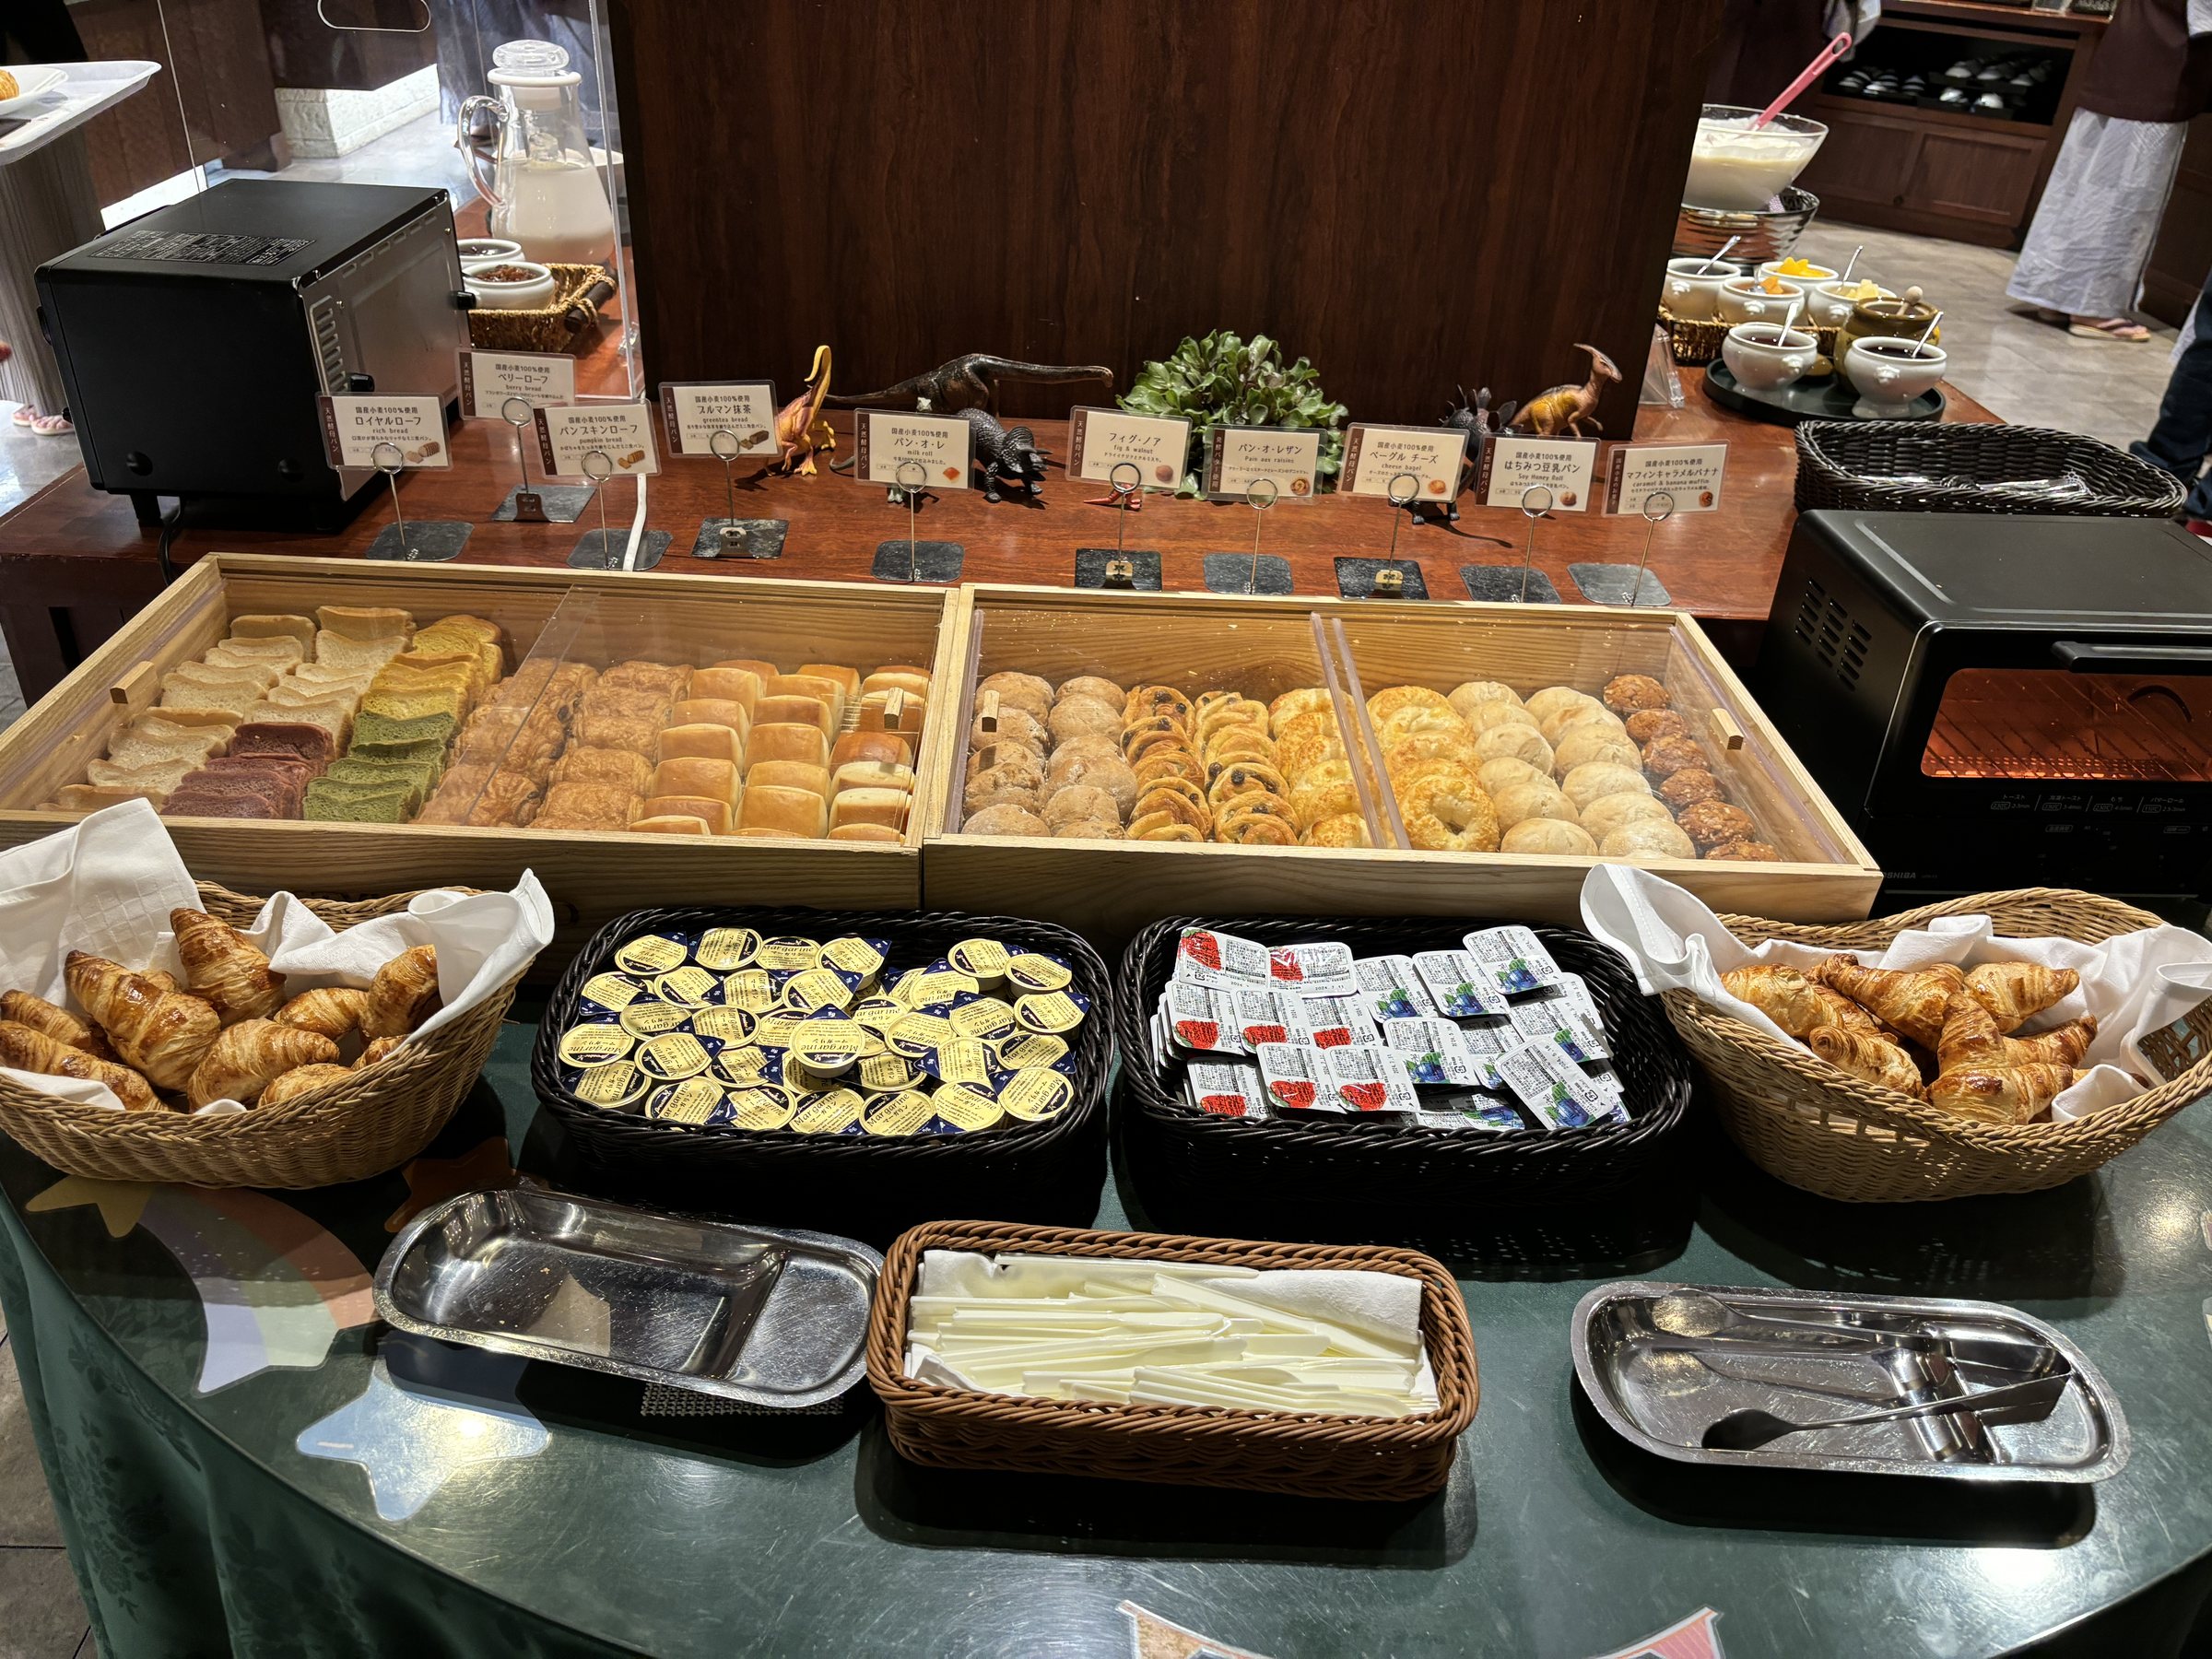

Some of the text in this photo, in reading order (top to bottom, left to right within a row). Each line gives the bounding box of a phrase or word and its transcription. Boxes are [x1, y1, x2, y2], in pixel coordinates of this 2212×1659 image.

[498, 373, 548, 384] ベリーローフ
[355, 417, 421, 426] ロイヤルローフ
[559, 424, 638, 436] パンプキンローフ
[891, 427, 948, 439] 国産小麦100%使用
[1109, 432, 1161, 447] フィグ・ノア
[894, 438, 945, 450] パン・オ・レ
[1239, 443, 1302, 455] パン・オ・レザン
[1377, 441, 1434, 453] 国産小麦100%使用
[1370, 452, 1439, 465] ベーグル チーズ
[1515, 451, 1572, 462] 国産小麦100%使用
[1504, 460, 1581, 474] はちみつ豆乳パン
[1627, 467, 1719, 479] マフィンキャラメルバナナ
[763, 945, 815, 953] Margarine
[625, 951, 669, 969] Margarine
[826, 948, 853, 971] argarine
[962, 945, 983, 974] Margarine
[1013, 964, 1055, 987] Margarine
[759, 972, 770, 1006] Margarine
[920, 994, 953, 1004] garine
[857, 1007, 900, 1018] argarine
[1028, 1000, 1055, 1030] Margarine
[728, 1007, 742, 1041] Margarine
[969, 1015, 1015, 1035] Margarine
[801, 1043, 858, 1053] Margarine
[1006, 1034, 1041, 1062] Margarine
[651, 1042, 677, 1077] Margarine
[972, 1041, 983, 1080] Margarine
[610, 1064, 634, 1101] Margarine
[664, 1082, 691, 1118] argarine
[949, 1084, 996, 1111] Margarine
[1029, 1077, 1063, 1113] Margarine
[794, 1091, 840, 1125] Margarine
[866, 1094, 910, 1126] Margarine
